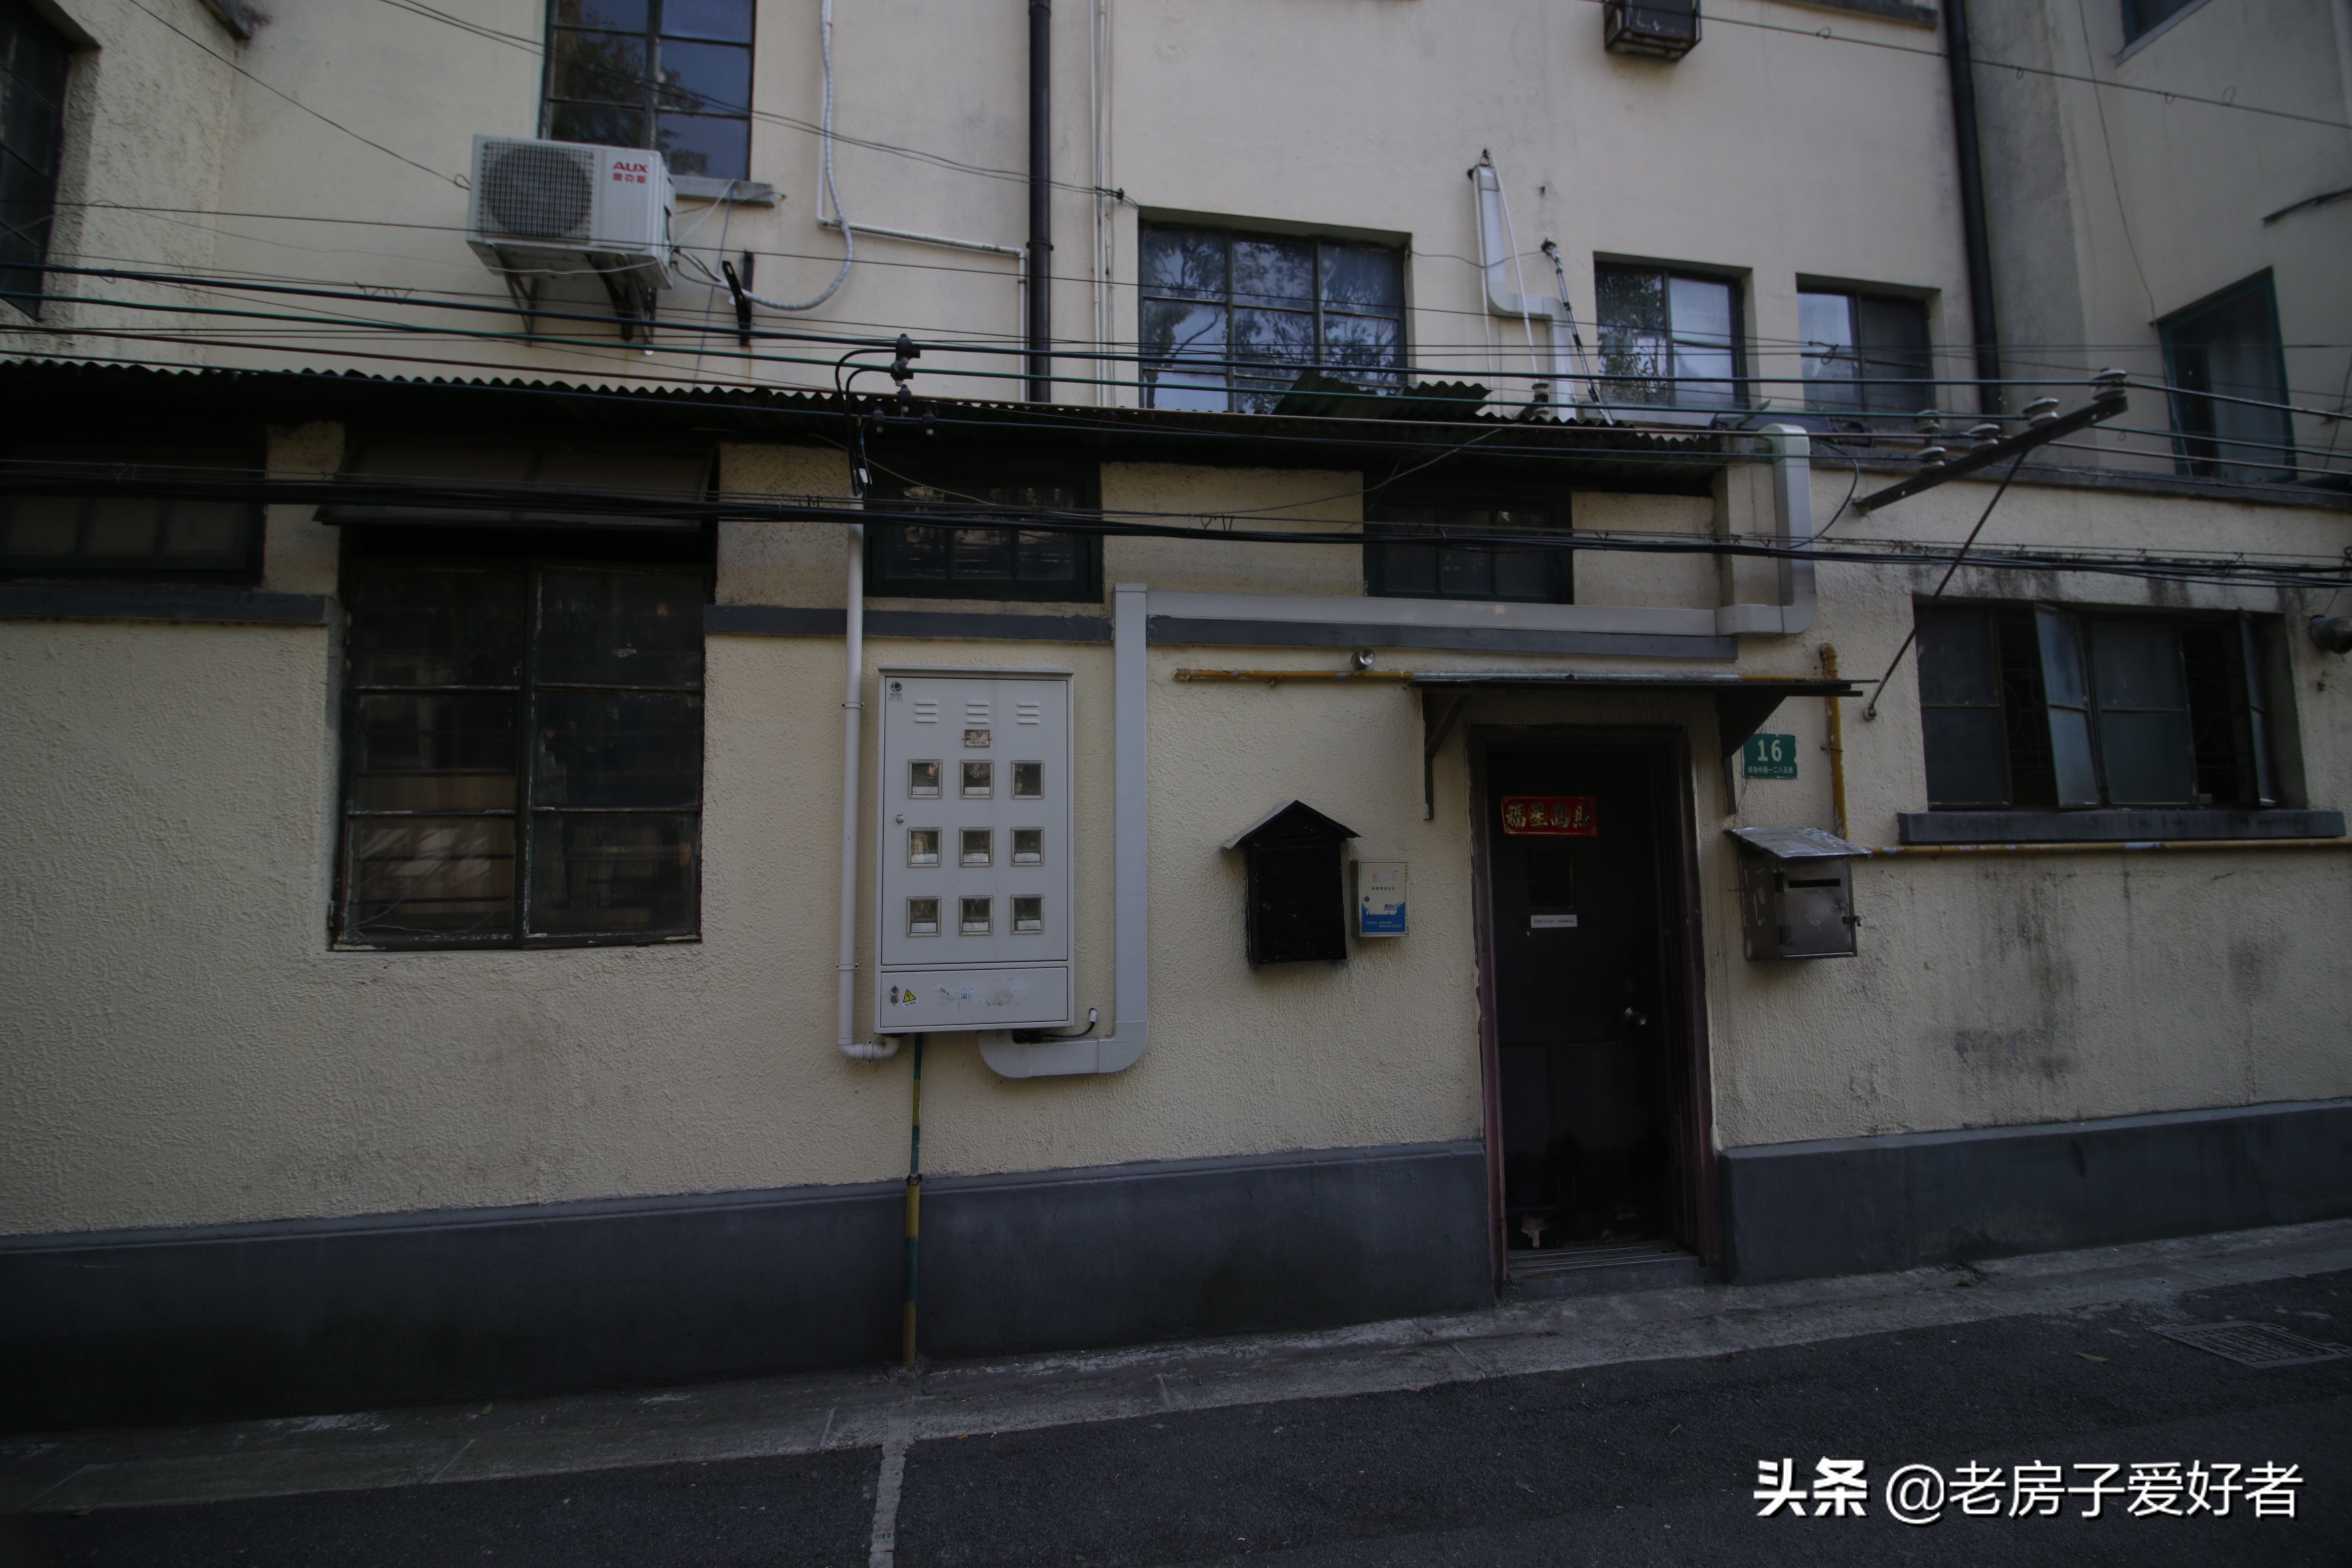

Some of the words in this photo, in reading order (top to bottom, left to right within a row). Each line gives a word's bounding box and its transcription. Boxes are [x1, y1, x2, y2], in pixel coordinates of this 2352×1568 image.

[613, 162, 647, 173] AUX
[613, 173, 646, 184] 奥克斯
[1758, 740, 1782, 762] 16
